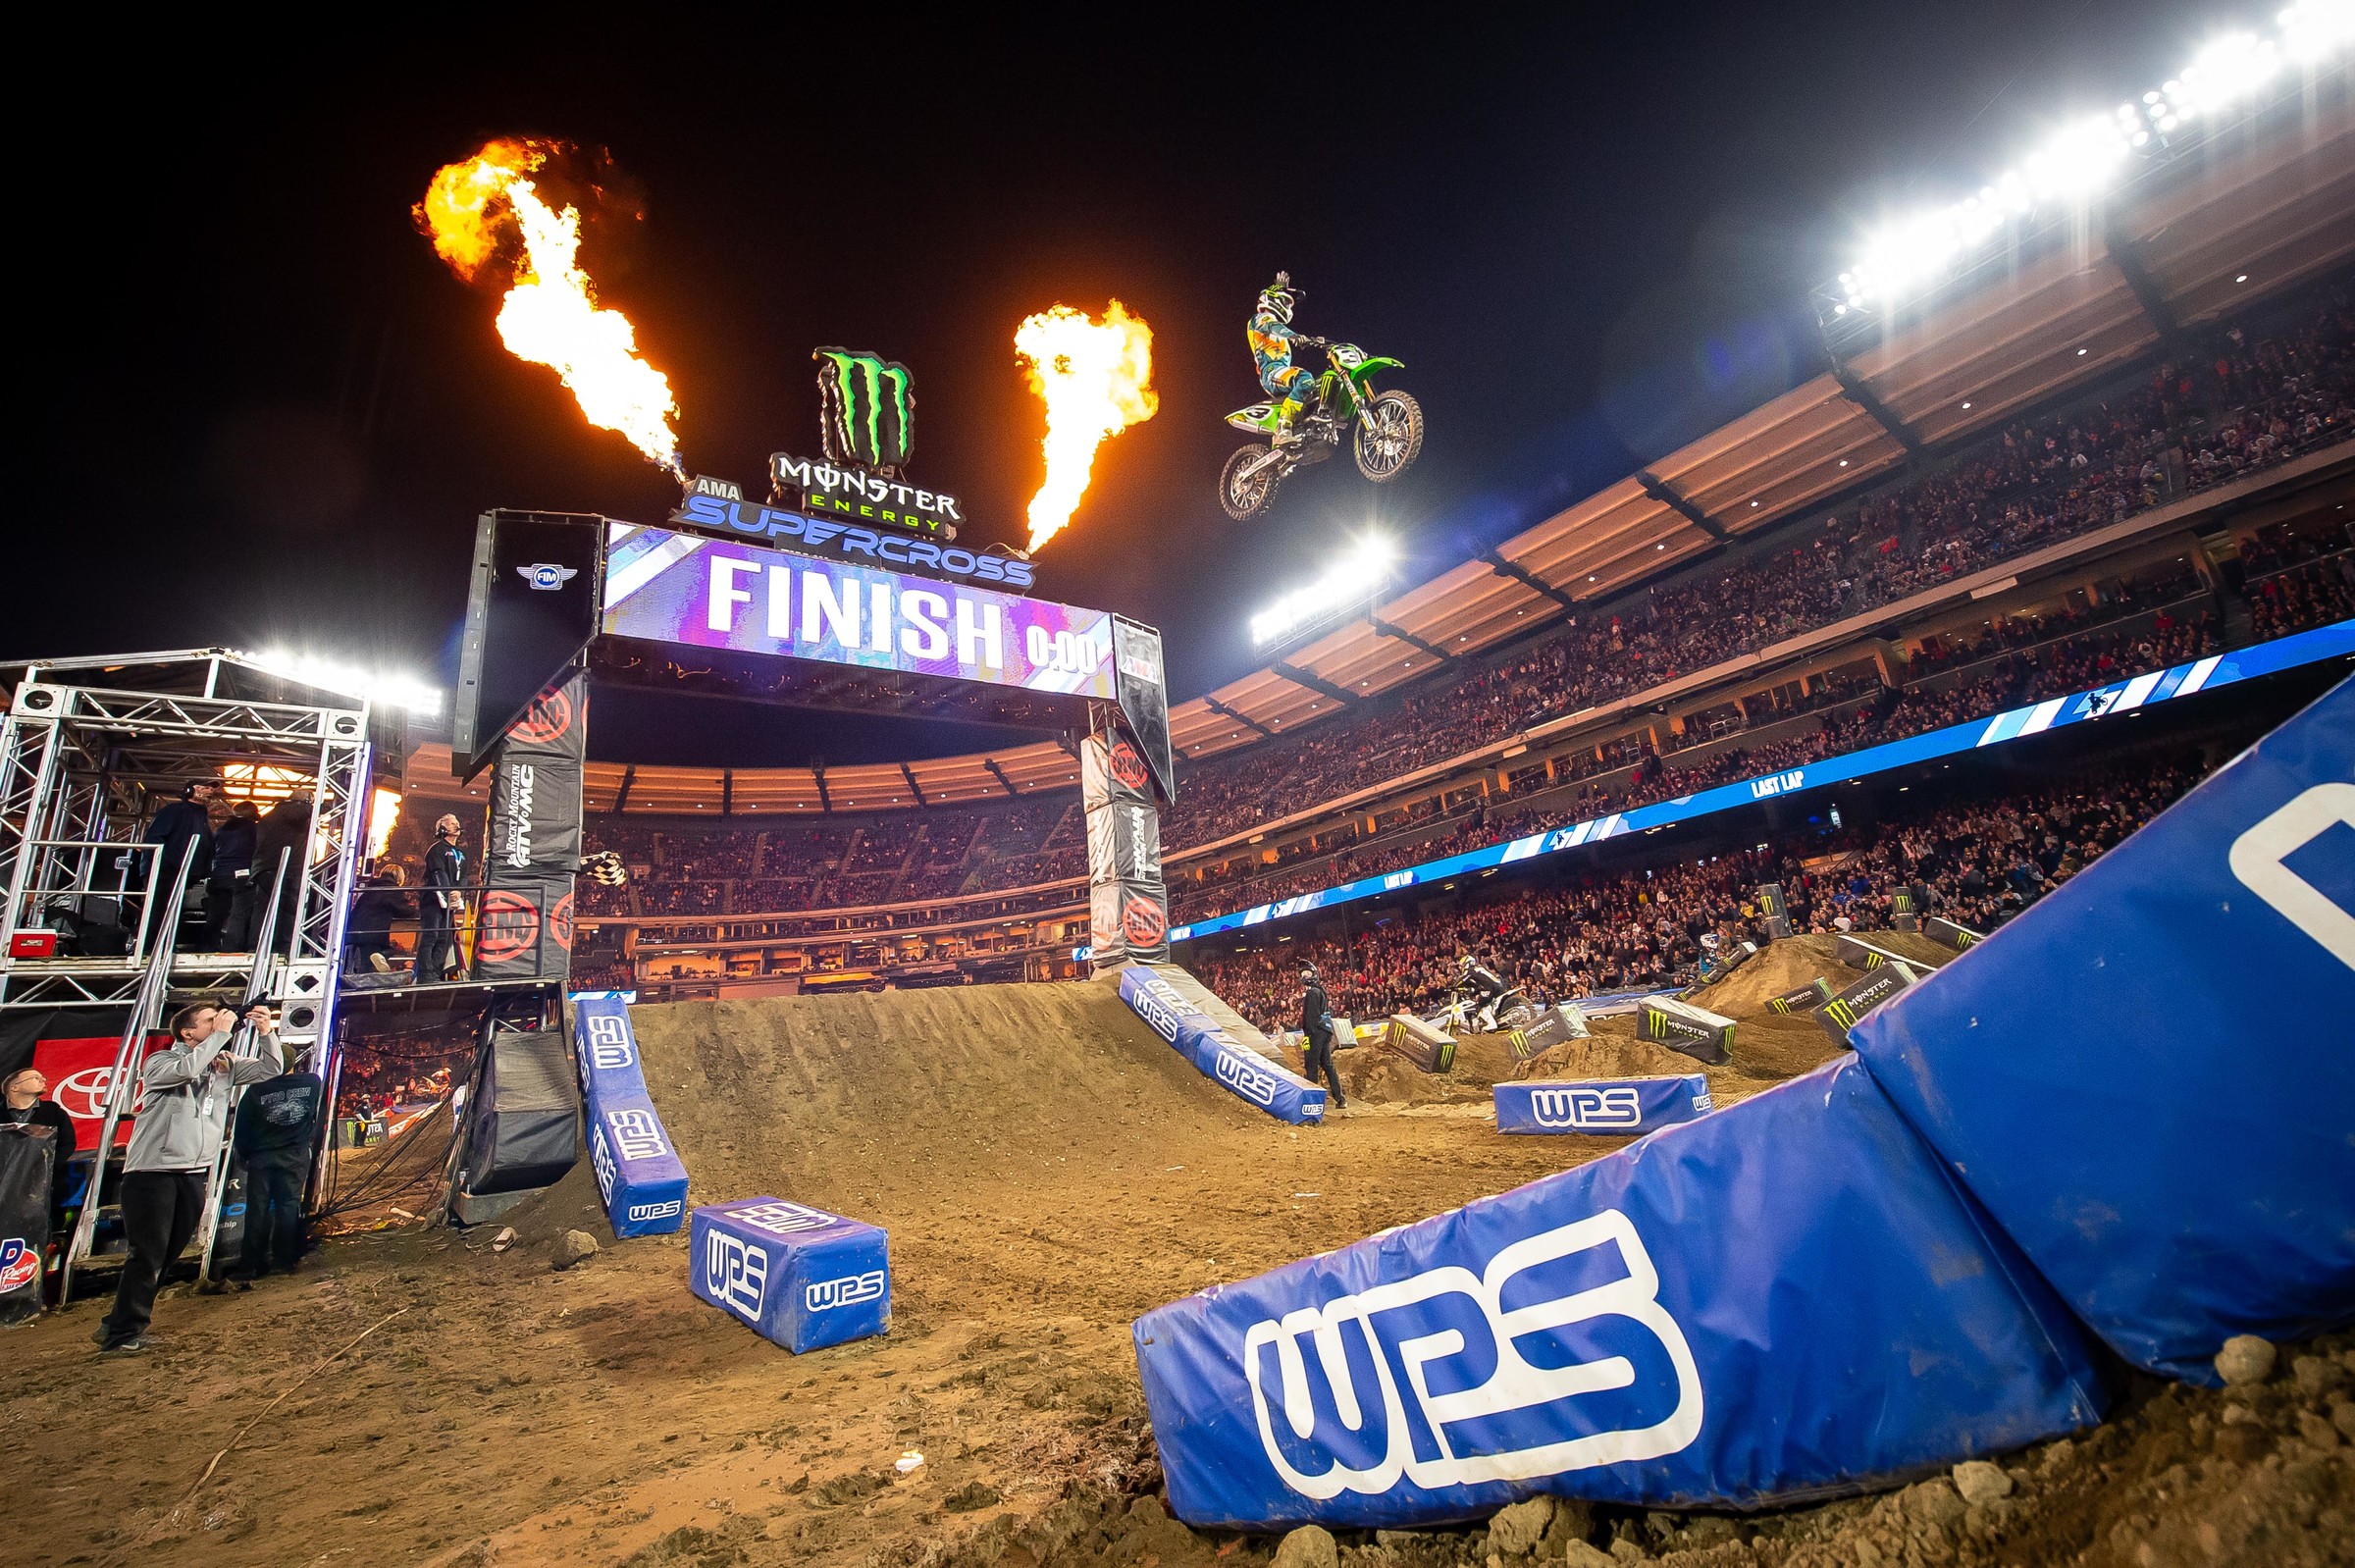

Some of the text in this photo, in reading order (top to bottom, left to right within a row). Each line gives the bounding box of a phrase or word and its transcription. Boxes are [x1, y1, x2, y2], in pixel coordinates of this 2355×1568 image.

[697, 478, 741, 500] AMA
[778, 456, 962, 520] MONSTER
[811, 494, 941, 532] ENERGY
[683, 495, 1035, 588] SUPERCROSS
[537, 571, 557, 583] FIM
[706, 553, 1005, 671] FINISH
[1751, 770, 1805, 799] LAST LAP
[506, 764, 520, 852] ROCKY MOUNTAIN
[1847, 977, 1893, 1008] MONSTER
[1132, 988, 1178, 1043] WPS
[1667, 1019, 1710, 1039] MONSTER
[588, 1015, 634, 1070] WPS
[261, 1086, 312, 1106] PYRO CREW
[1216, 1049, 1277, 1107] WPS
[1301, 1103, 1324, 1116] WPS
[1530, 1088, 1643, 1128] WPS
[607, 1108, 668, 1162] WPS
[592, 1123, 618, 1208] WPS
[628, 1199, 681, 1222] WPS
[720, 1200, 839, 1235] WPS
[0, 1237, 26, 1276] P
[2, 1261, 39, 1286] Racing
[706, 1228, 768, 1323] WPS
[806, 1269, 885, 1314] WPS
[1243, 1208, 1704, 1501] WPS
